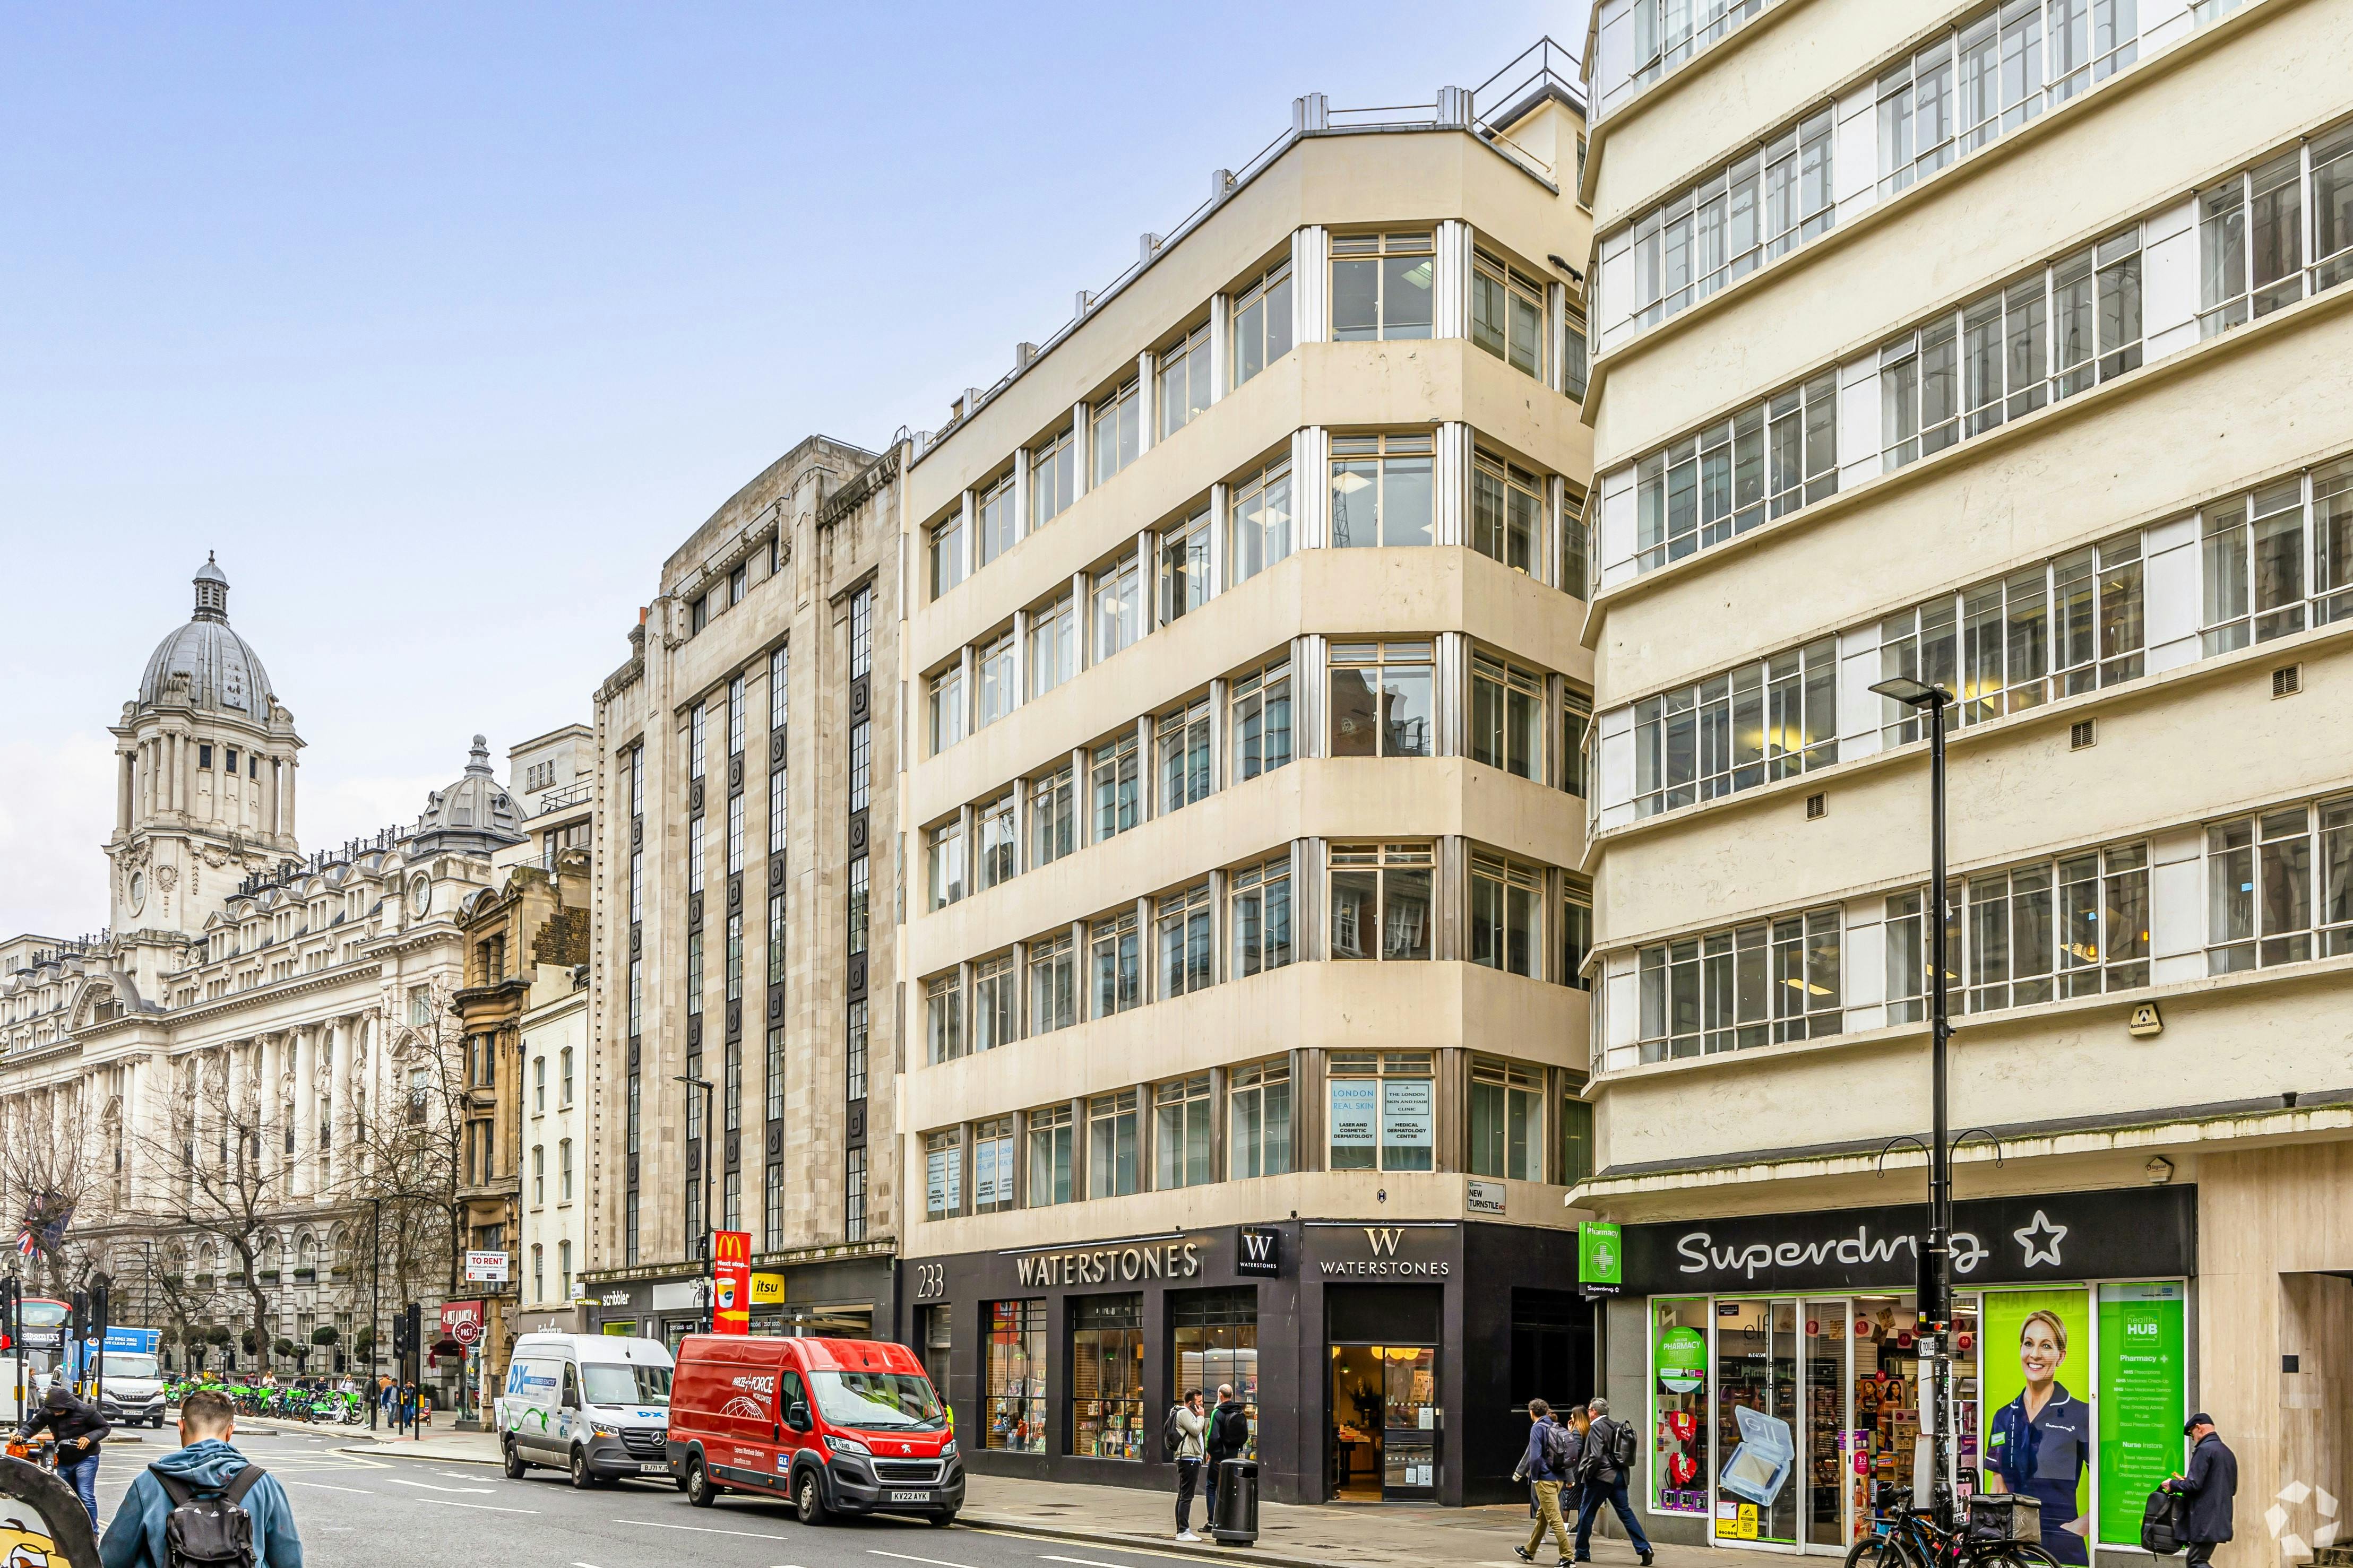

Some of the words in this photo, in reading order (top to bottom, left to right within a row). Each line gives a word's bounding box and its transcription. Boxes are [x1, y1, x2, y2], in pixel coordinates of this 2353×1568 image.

[1469, 1189, 1483, 1198] NEW
[1469, 1199, 1498, 1209] TURNSTILE
[1587, 1227, 1618, 1238] Pharmacy
[1244, 1235, 1273, 1260] W
[1364, 1228, 1405, 1256] W
[1017, 1242, 1198, 1287] WATERSTONES
[1321, 1261, 1449, 1275] WATERSTONES
[756, 1280, 778, 1293] itsu
[918, 1263, 945, 1298] 233
[603, 1290, 630, 1306] scribbler
[2127, 1324, 2157, 1335] HUB
[1664, 1341, 1700, 1350] PHARMACY
[1923, 1342, 1934, 1351] TOILE
[1669, 1349, 1695, 1362] FIRST
[2120, 1355, 2157, 1363] Pharmacy
[508, 1365, 529, 1394] DX
[732, 1377, 746, 1388] PARCEL
[751, 1376, 774, 1394] FORCE
[753, 1392, 772, 1405] WORLDWIDE
[779, 1457, 787, 1466] GLS
